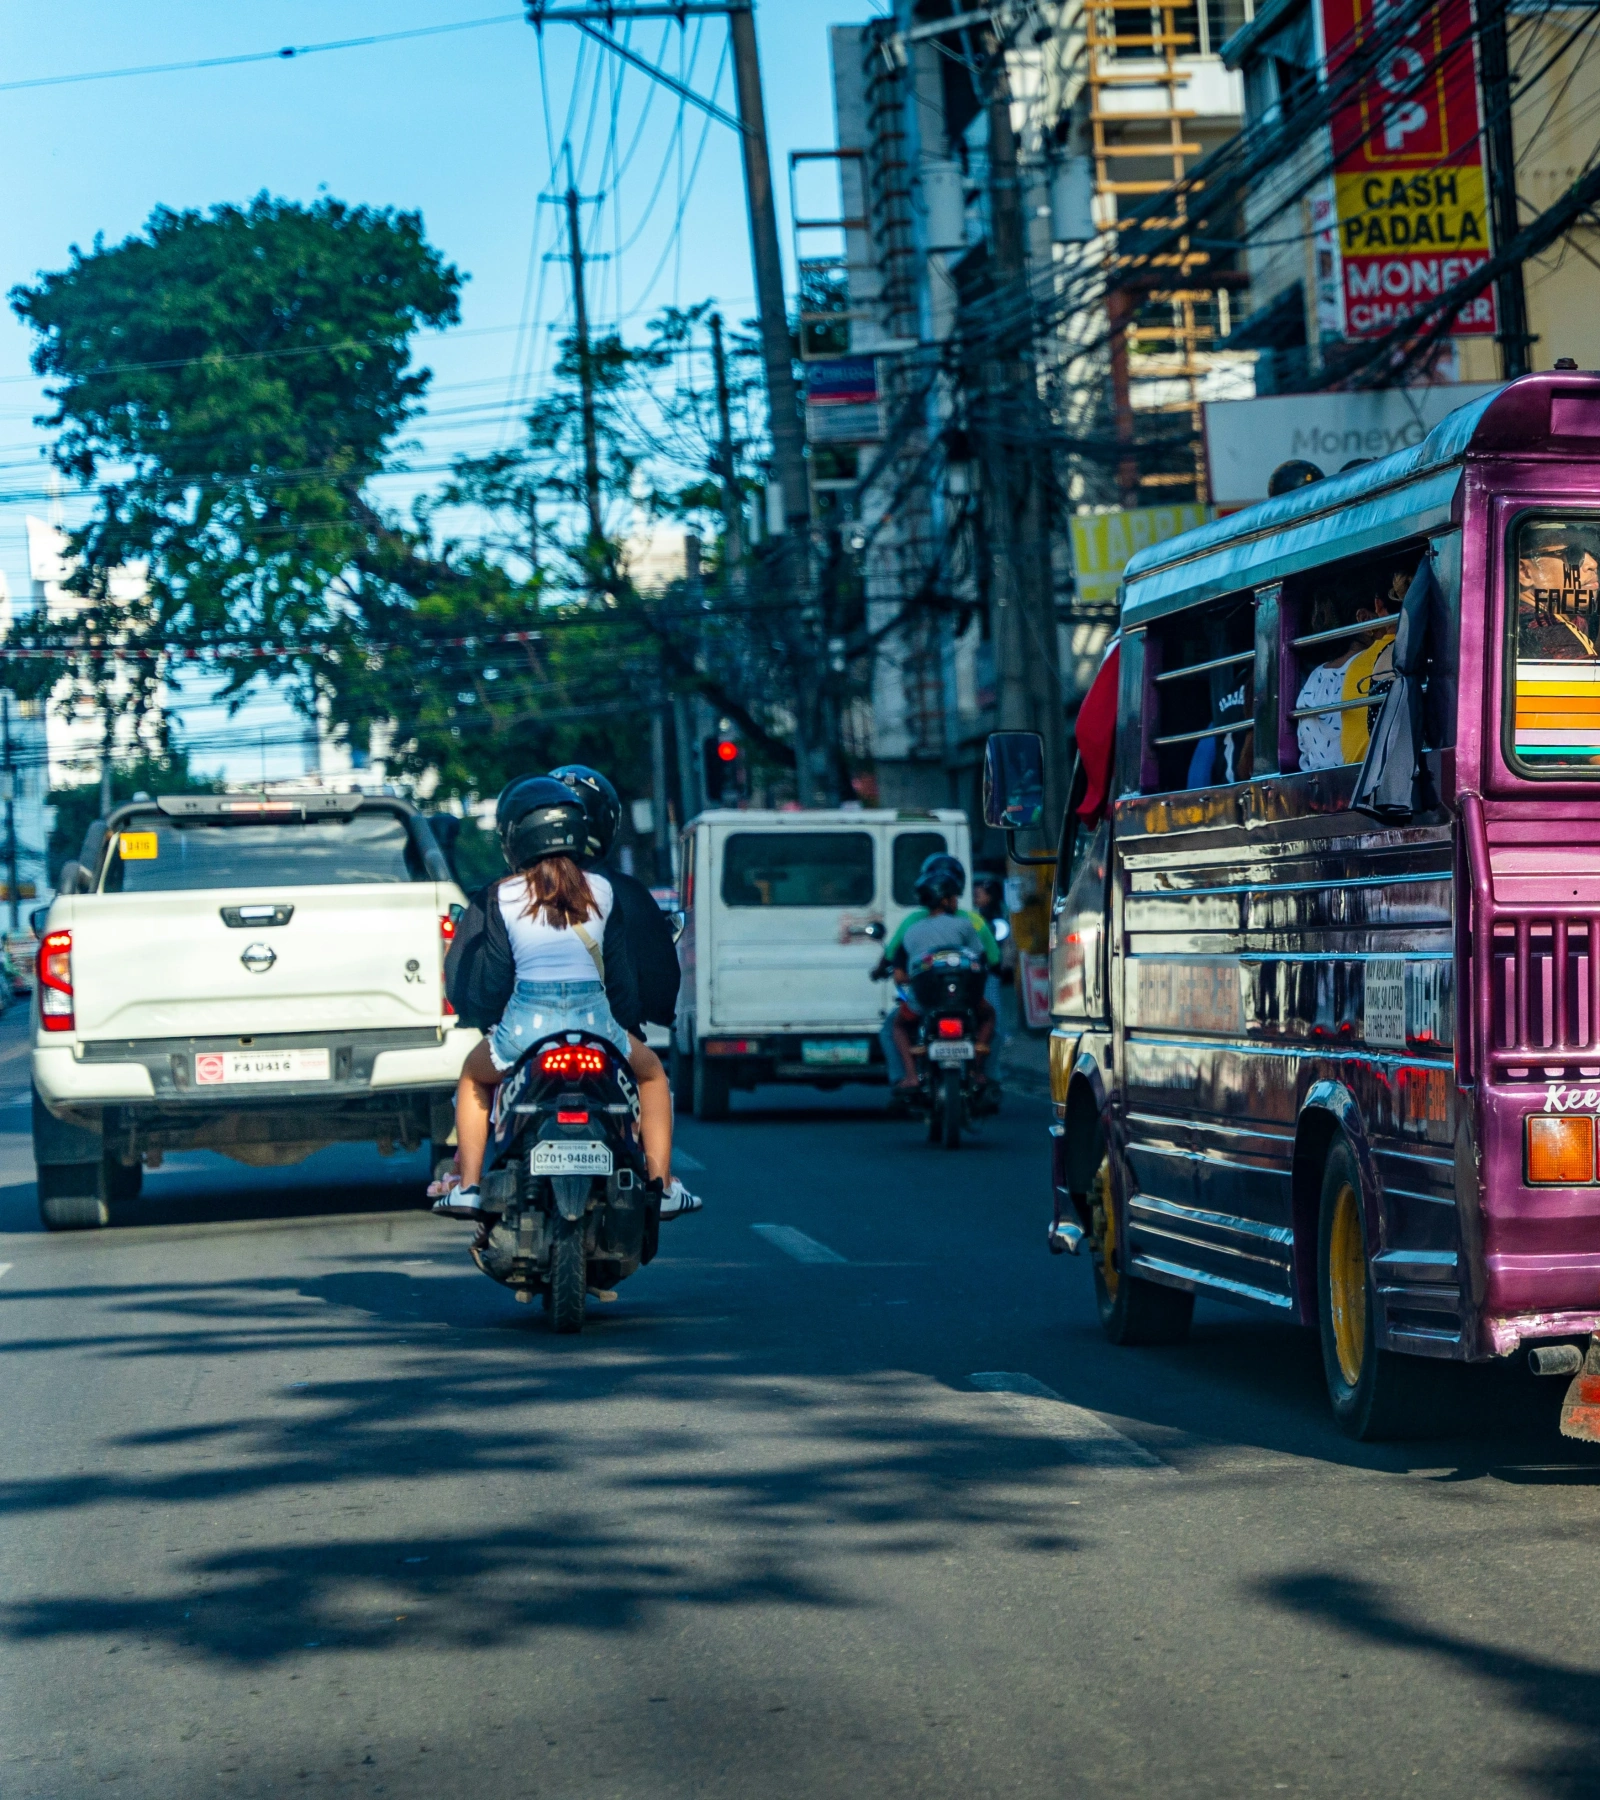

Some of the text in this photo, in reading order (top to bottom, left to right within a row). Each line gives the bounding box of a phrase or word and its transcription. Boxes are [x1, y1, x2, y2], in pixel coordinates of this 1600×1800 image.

[1363, 174, 1457, 209] CASH
[1345, 211, 1482, 248] PADALA
[404, 973, 427, 984] VL
